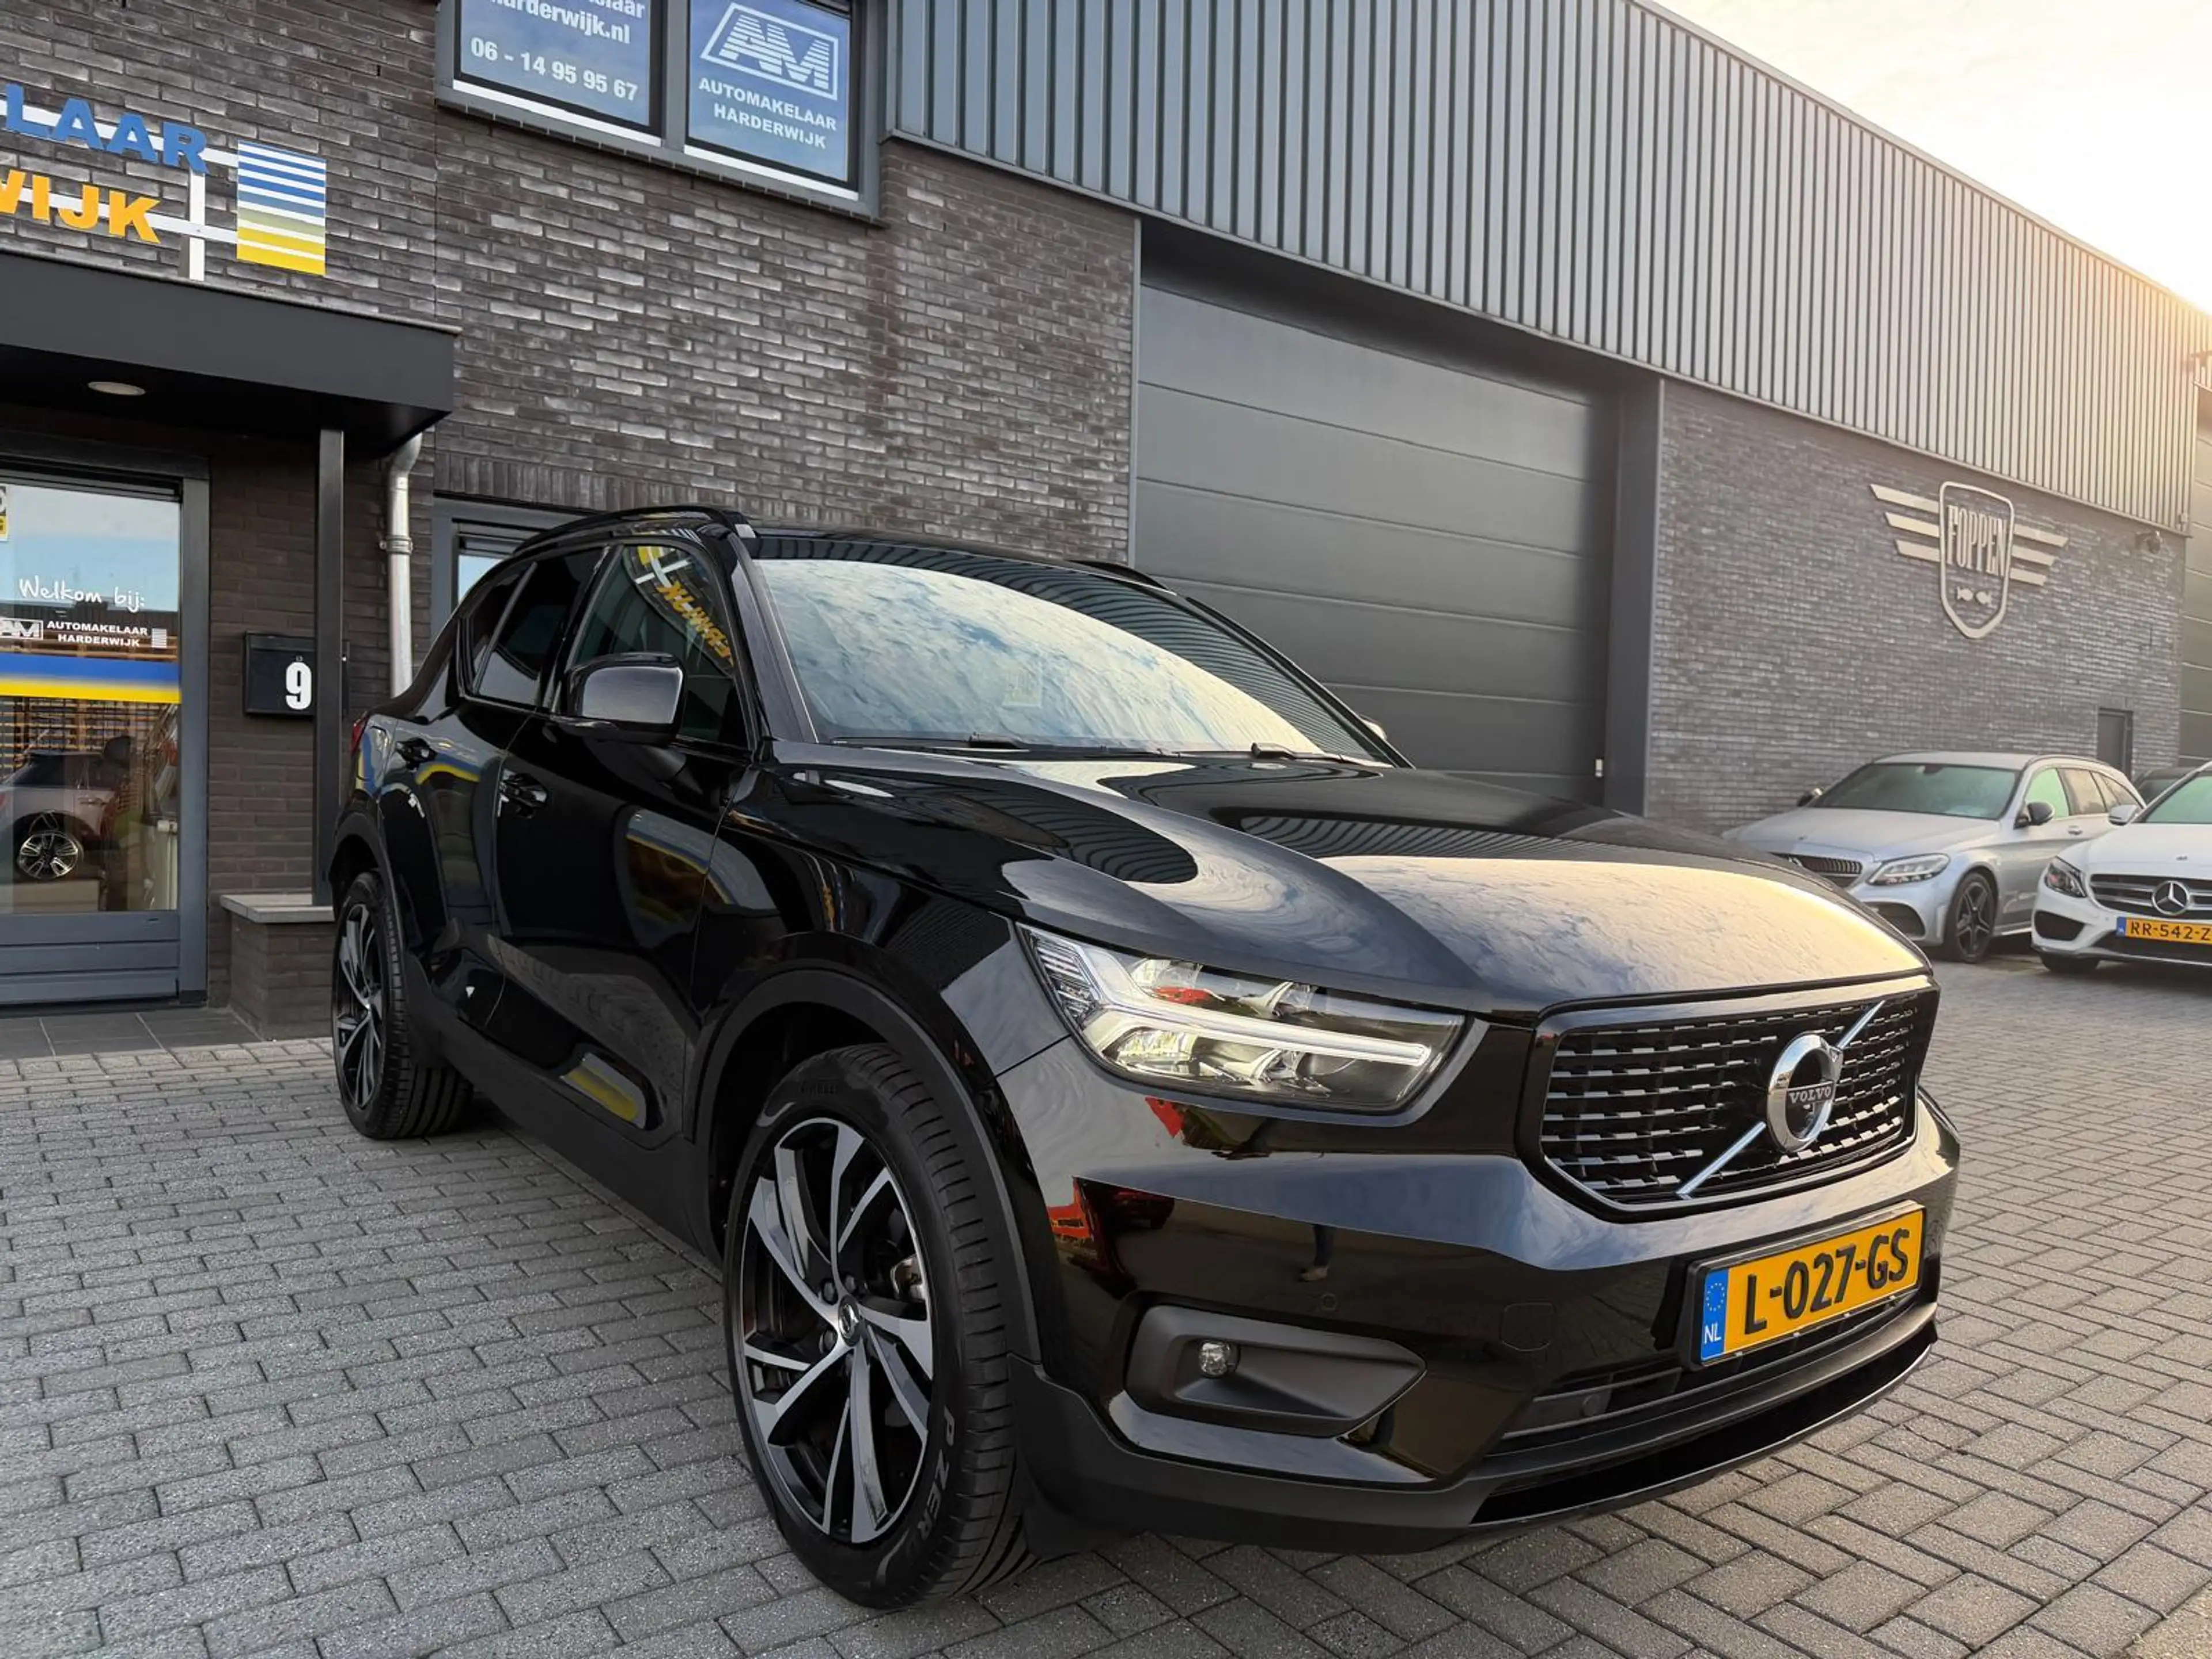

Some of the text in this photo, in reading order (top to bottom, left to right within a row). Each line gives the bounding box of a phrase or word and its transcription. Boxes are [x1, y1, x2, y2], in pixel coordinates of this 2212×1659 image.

[493, 0, 630, 44] arderwijk.nl
[471, 37, 498, 61] 06
[520, 52, 546, 76] 14
[551, 61, 577, 84] 95
[582, 70, 608, 93] 95
[613, 79, 638, 101] 67
[699, 78, 836, 131] AUTOMAKELAAR
[713, 103, 826, 149] HARDERWIJK
[6, 84, 209, 173] LAAR
[19, 575, 145, 613] Welkom bij:
[47, 620, 147, 635] AUTOMAKELAAR
[58, 634, 140, 647] HARDERWIJK
[286, 662, 312, 710] 9
[2131, 921, 2210, 941] RR-542-Z
[1789, 1086, 1832, 1104] VOLVO
[1744, 1228, 1910, 1335] L-027-GS
[1703, 1322, 1722, 1344] NL
